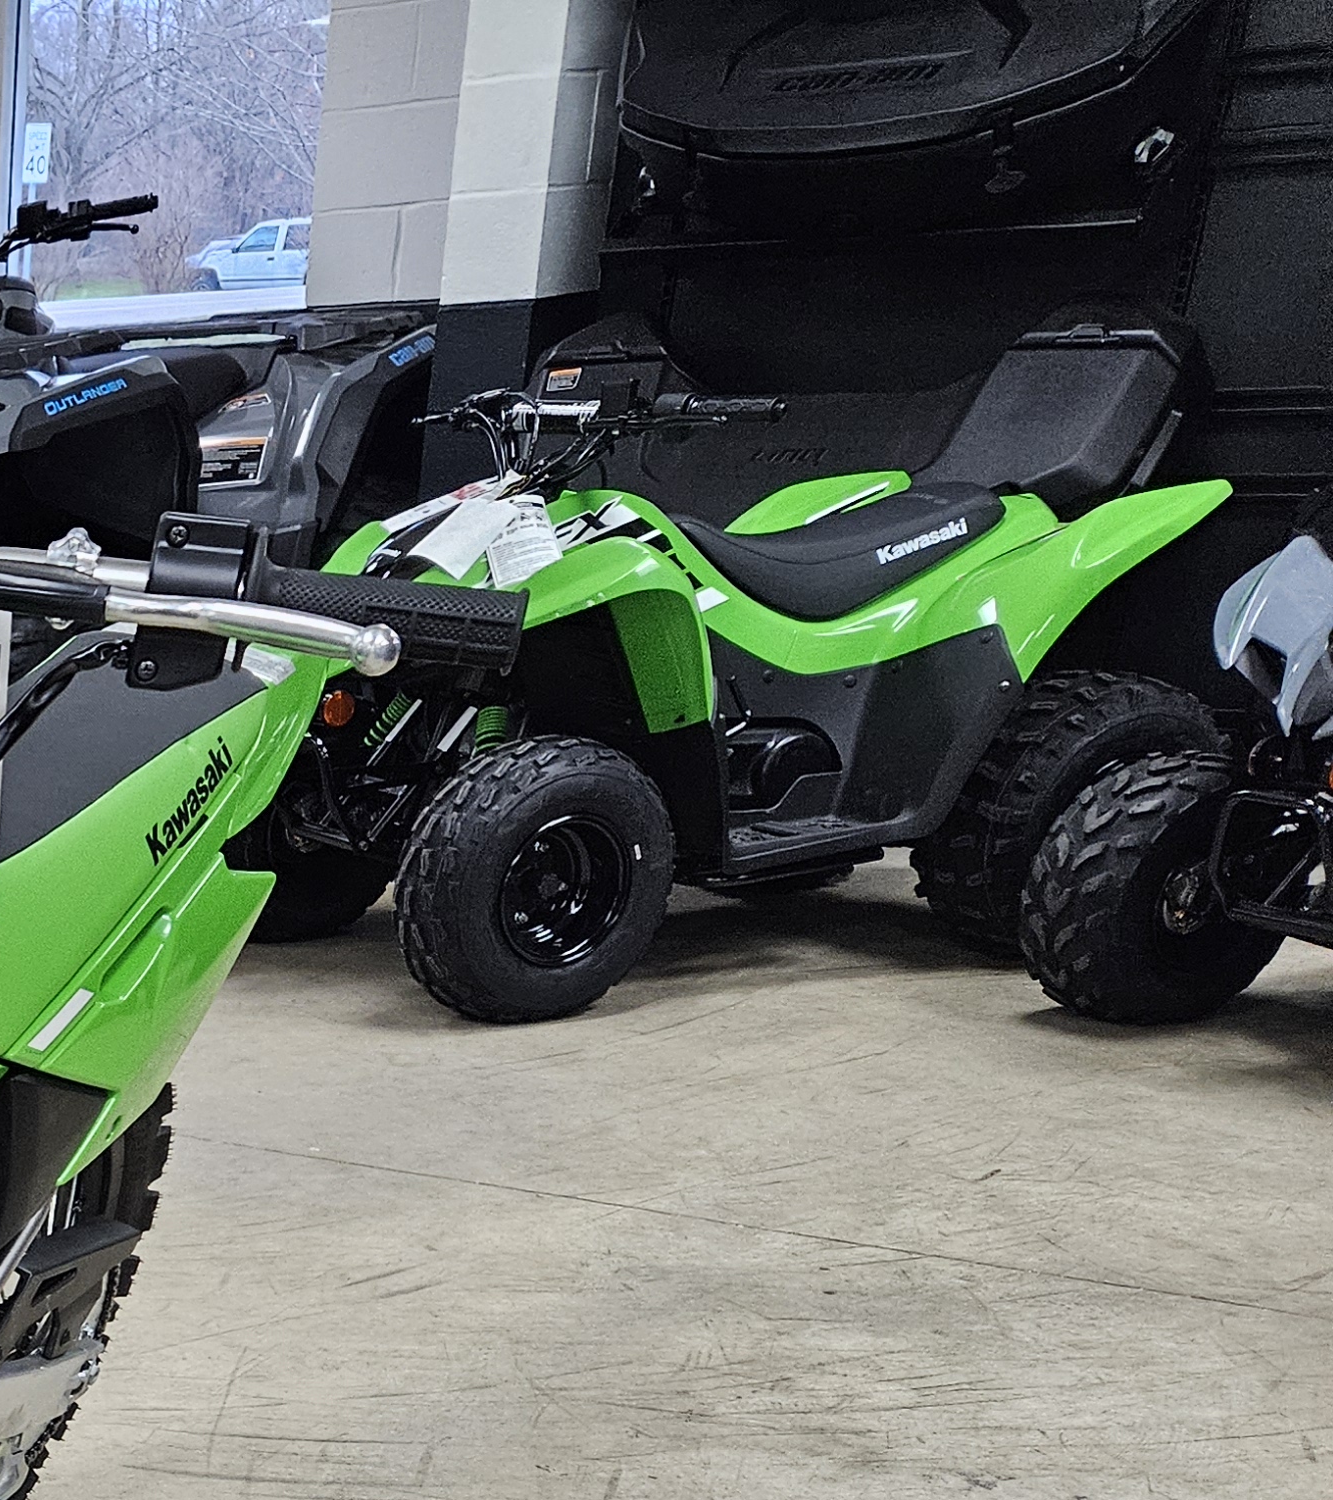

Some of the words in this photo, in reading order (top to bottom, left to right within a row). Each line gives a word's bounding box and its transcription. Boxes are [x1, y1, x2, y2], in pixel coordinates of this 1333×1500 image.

[25, 155, 46, 175] 40
[44, 378, 128, 416] OUTLANDER
[875, 517, 969, 565] Kawasaki
[144, 735, 233, 867] Kawasaki
